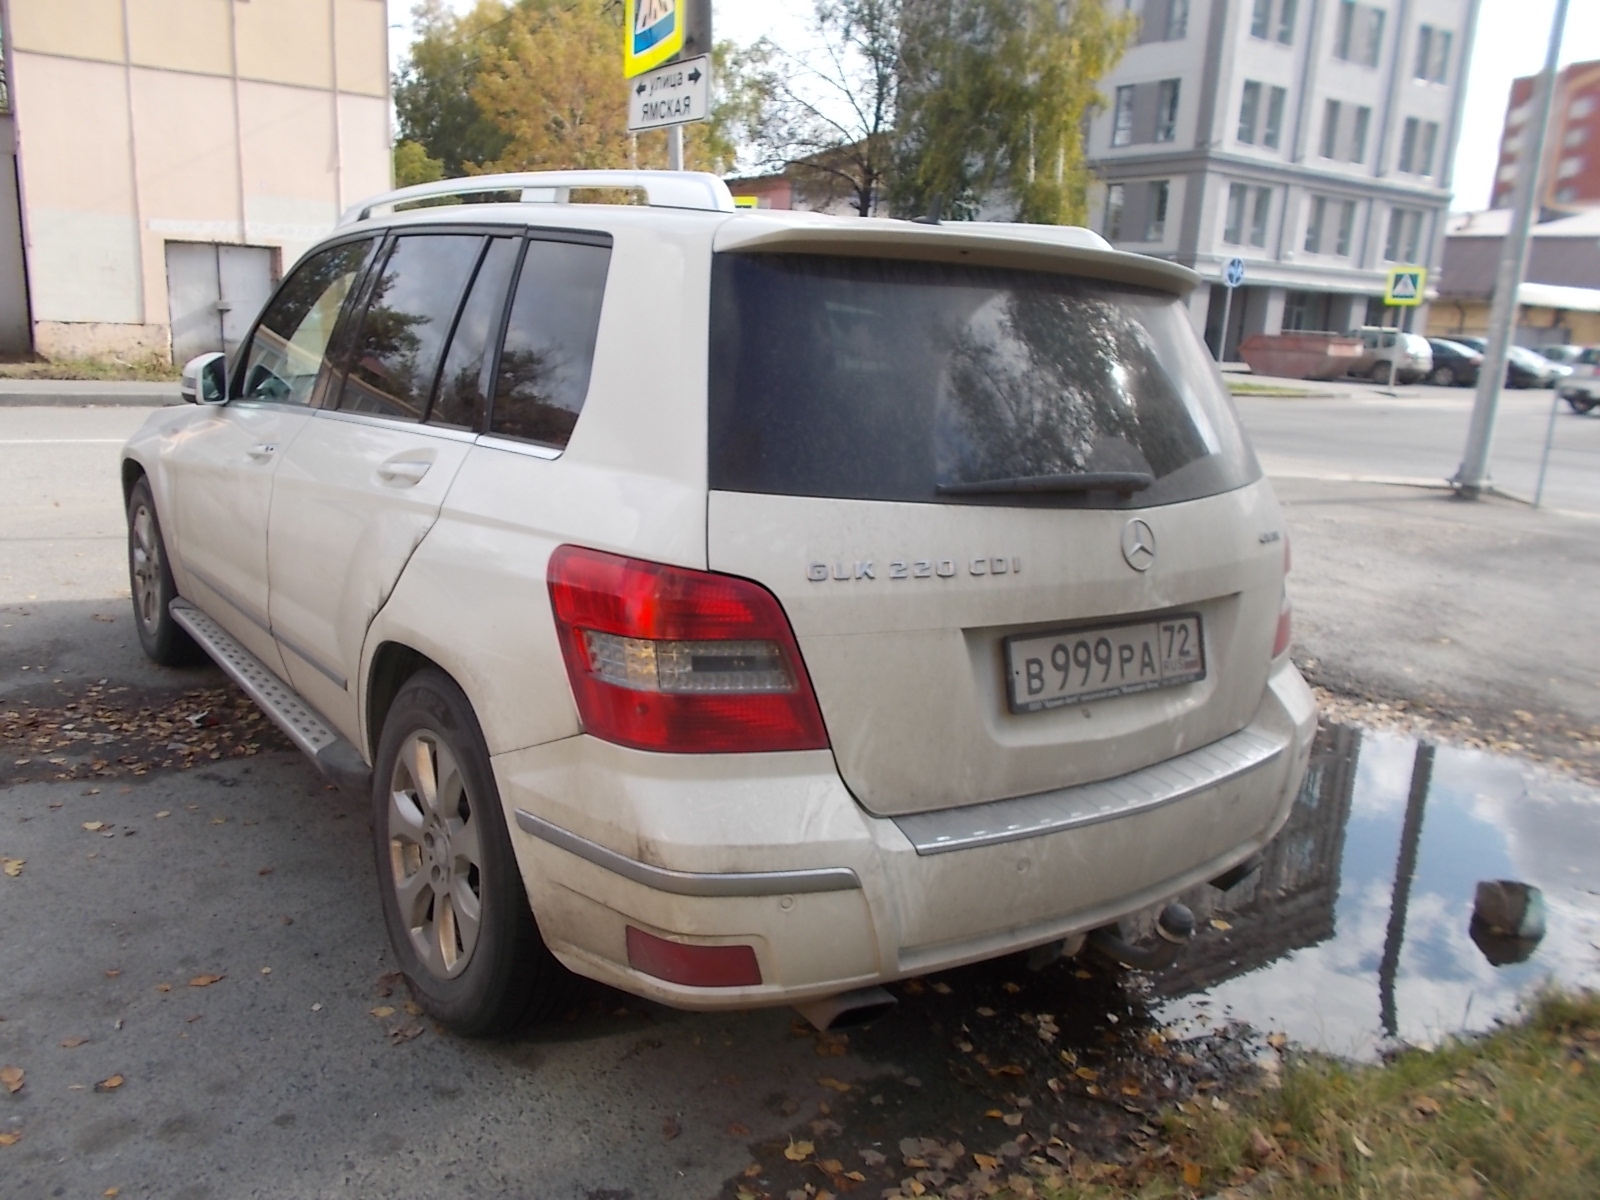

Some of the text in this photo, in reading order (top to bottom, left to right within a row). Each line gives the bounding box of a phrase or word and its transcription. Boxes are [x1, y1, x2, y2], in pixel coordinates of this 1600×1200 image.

[650, 72, 683, 96] улица
[642, 96, 691, 121] ЯМСКАЯ
[806, 557, 1022, 582] GLK 220 CDI
[1162, 623, 1191, 658] 72
